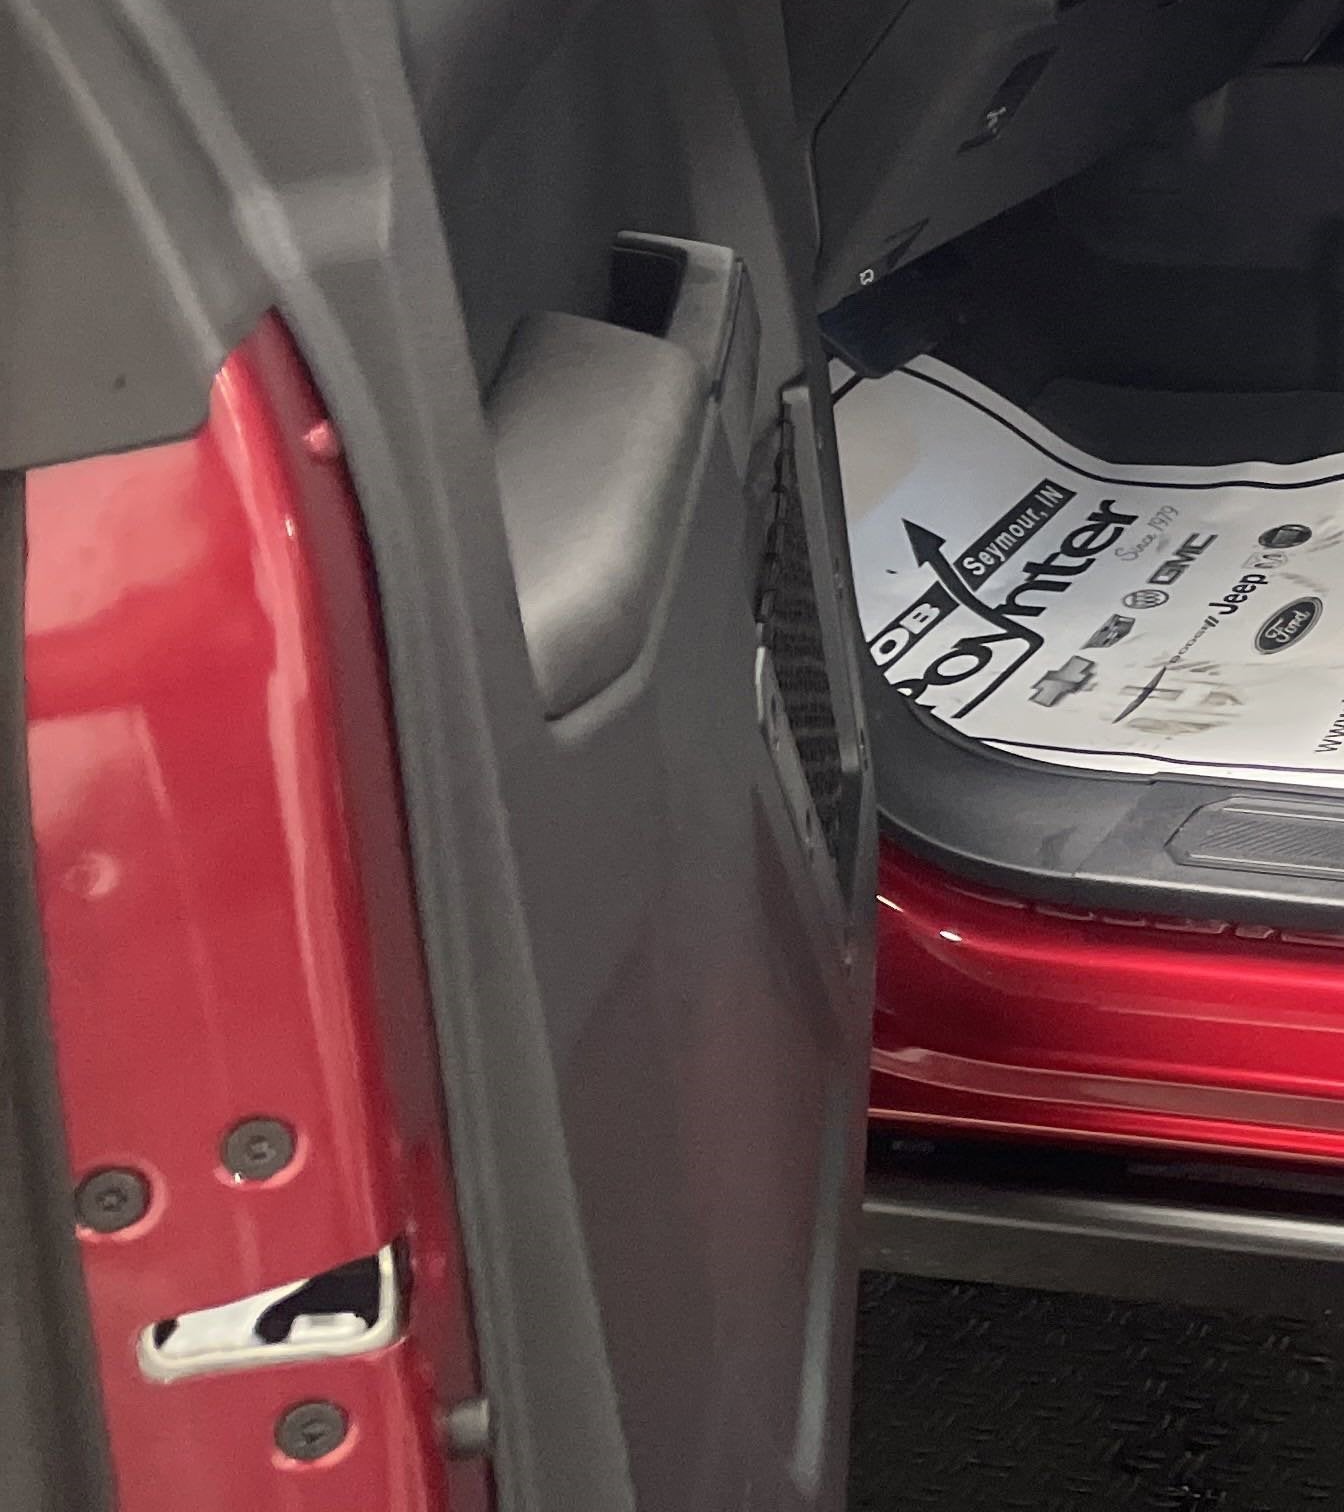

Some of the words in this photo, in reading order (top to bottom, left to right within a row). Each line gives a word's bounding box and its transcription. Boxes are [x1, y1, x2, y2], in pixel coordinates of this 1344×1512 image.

[962, 508, 1049, 576] Seymour,
[1034, 485, 1064, 509] IN
[1114, 533, 1157, 563] Since
[1147, 504, 1180, 532] 1979
[1147, 532, 1219, 586] GMC
[1208, 573, 1270, 616] Jeep
[868, 602, 941, 666] OB
[1264, 609, 1311, 644] Ford
